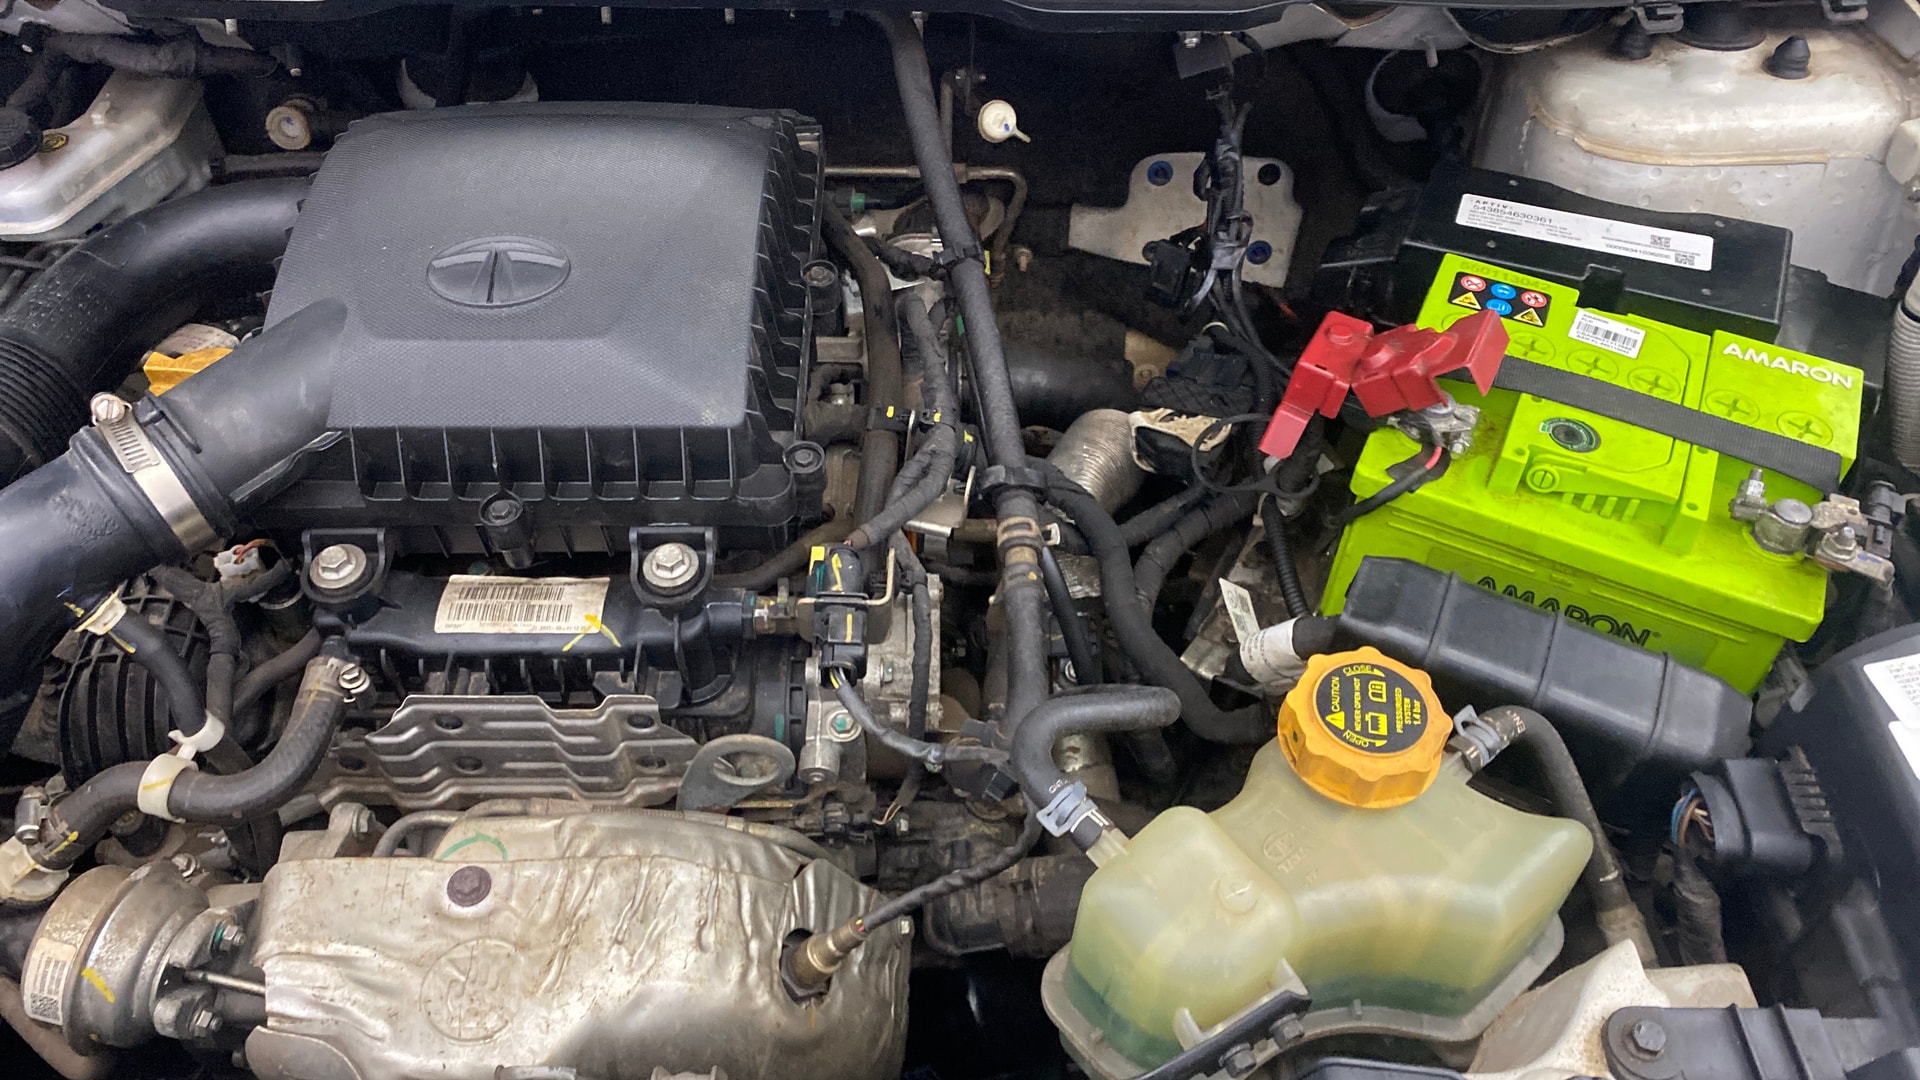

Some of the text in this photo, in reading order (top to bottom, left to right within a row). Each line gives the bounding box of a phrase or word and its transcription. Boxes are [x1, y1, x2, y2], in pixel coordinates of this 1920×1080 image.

[1475, 199, 1510, 209] APTIV
[1722, 342, 1853, 390] AMARON
[1331, 675, 1340, 712] CAUTION
[1353, 676, 1362, 732] NEVER OPEN HOT
[1412, 699, 1421, 713] bar
[1403, 697, 1412, 725] SYSTEM
[1342, 729, 1370, 748] OPEN
